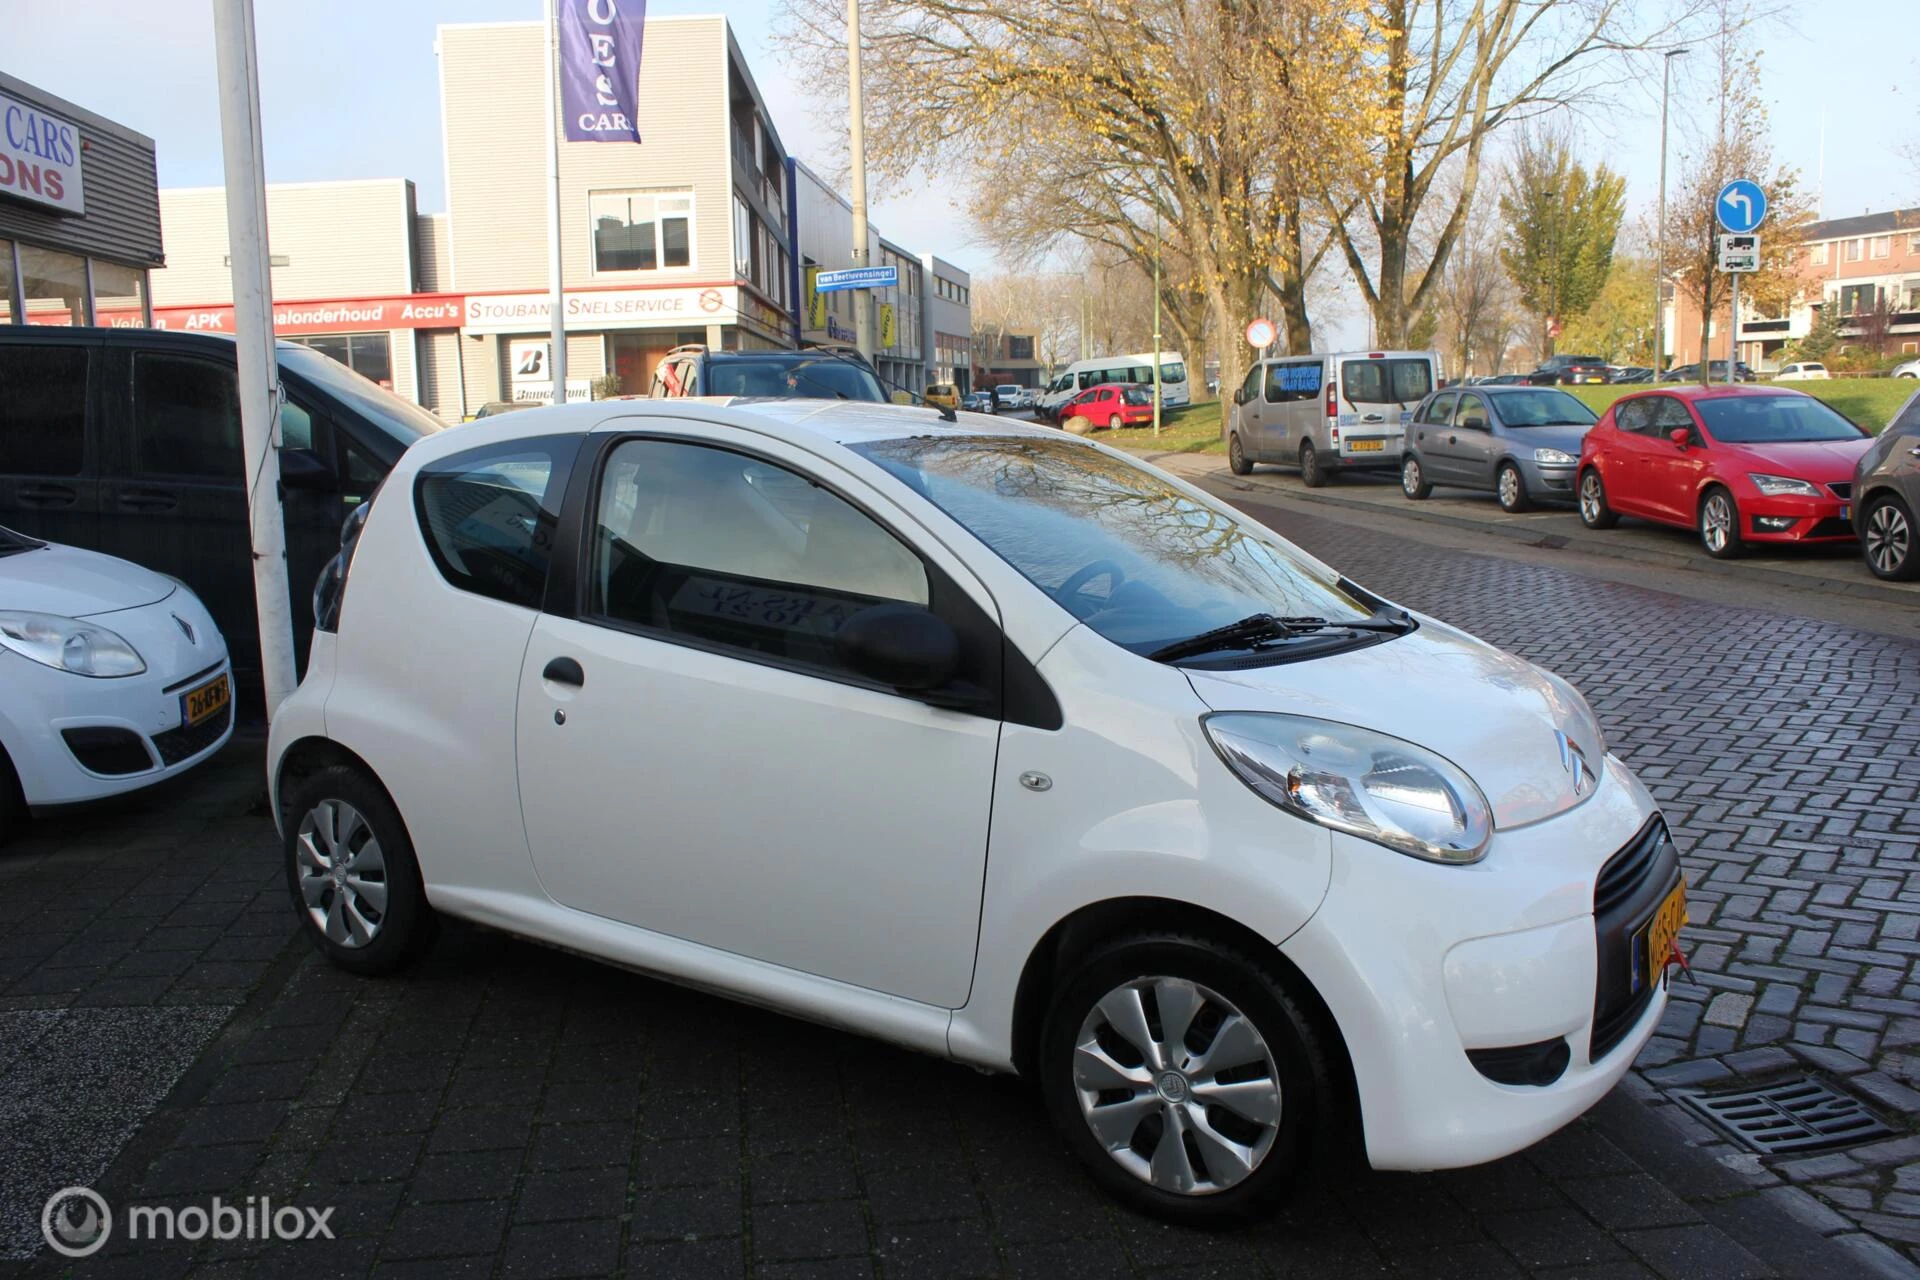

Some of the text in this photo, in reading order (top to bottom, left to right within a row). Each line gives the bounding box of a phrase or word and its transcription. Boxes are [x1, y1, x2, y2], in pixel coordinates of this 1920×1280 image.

[6, 105, 75, 168] CARS
[820, 269, 892, 283] van Beethovensingel
[568, 297, 684, 315] SNELSERVICE
[185, 313, 224, 329] APK
[272, 306, 383, 325] alonderhoud
[401, 303, 459, 320] Accu's
[516, 388, 589, 400] BRIDGEONE
